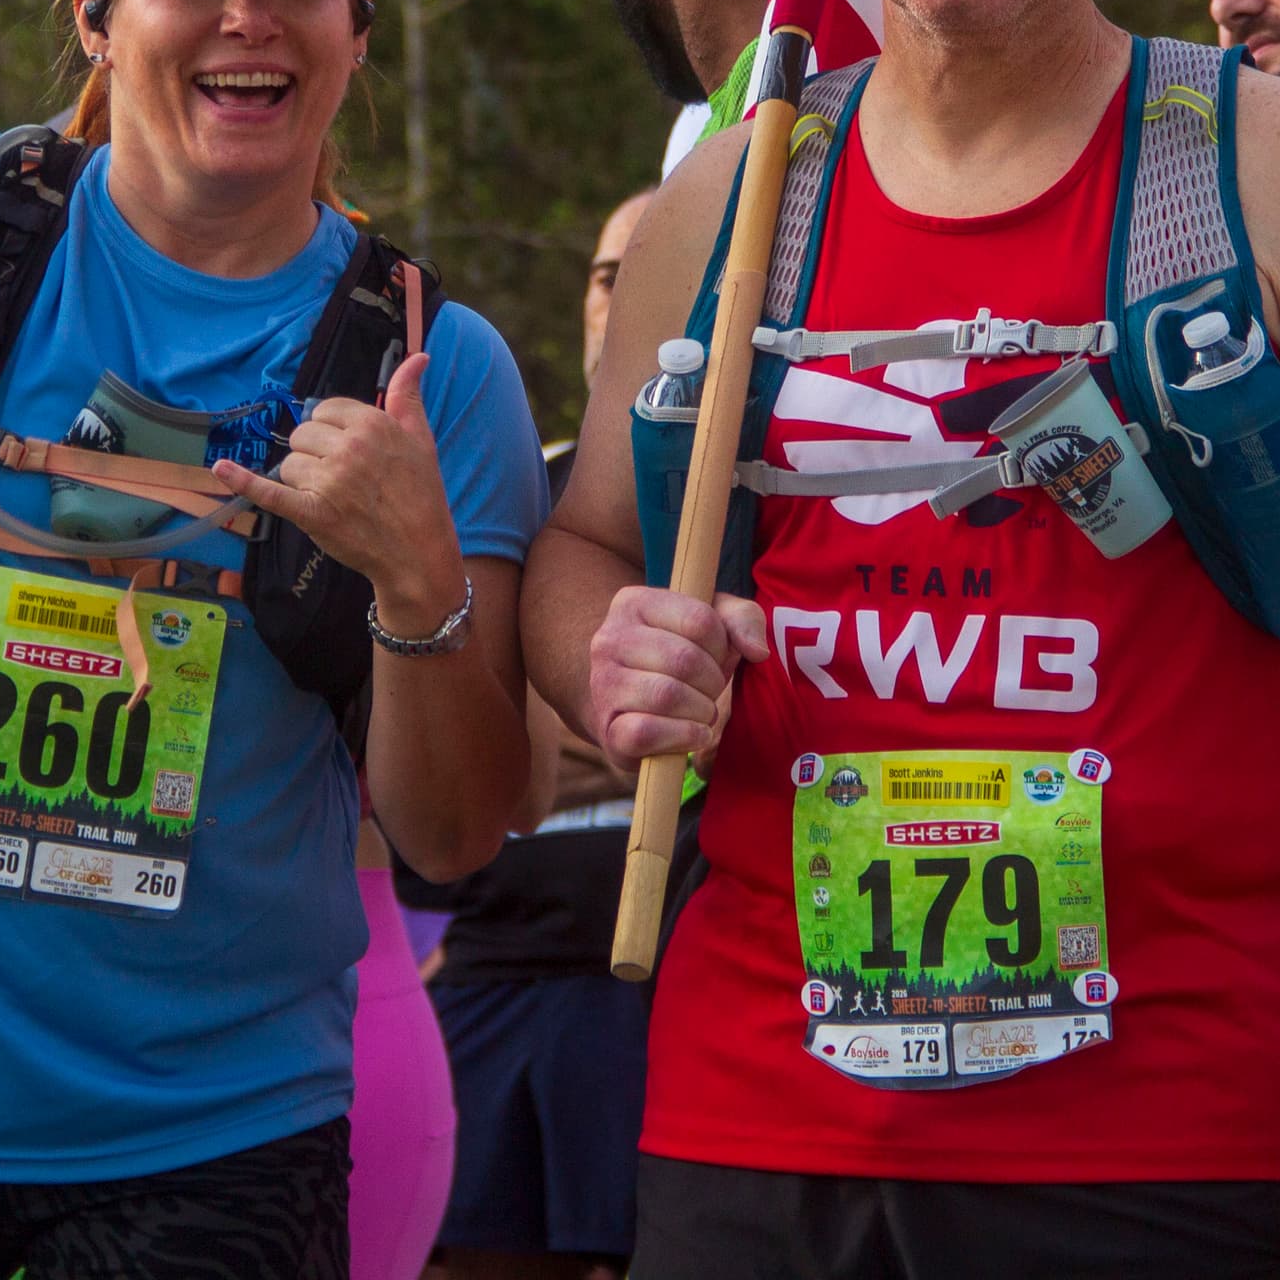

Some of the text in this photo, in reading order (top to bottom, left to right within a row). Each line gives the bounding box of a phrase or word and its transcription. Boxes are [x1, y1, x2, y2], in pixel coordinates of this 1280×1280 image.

[1029, 429, 1048, 444] FREE
[1112, 497, 1126, 508] VA
[855, 565, 992, 598] TEAM
[12, 645, 116, 675] SHEETZ
[773, 606, 1100, 713] RWB
[889, 768, 944, 779] Scott Jenkins
[1060, 818, 1091, 828] Bayside
[0, 836, 23, 848] CHECK
[77, 824, 110, 842] TRAIL
[113, 829, 138, 846] RUN
[893, 825, 993, 842] SHEETZ
[134, 871, 177, 897] 260
[857, 854, 1043, 971] 179
[892, 993, 1053, 1015] SHEETZ-TO-SHEETZ TRAIL RUN
[901, 1026, 940, 1035] BAG CHECK
[851, 1047, 889, 1061] Bayside
[903, 1039, 940, 1064] 179
